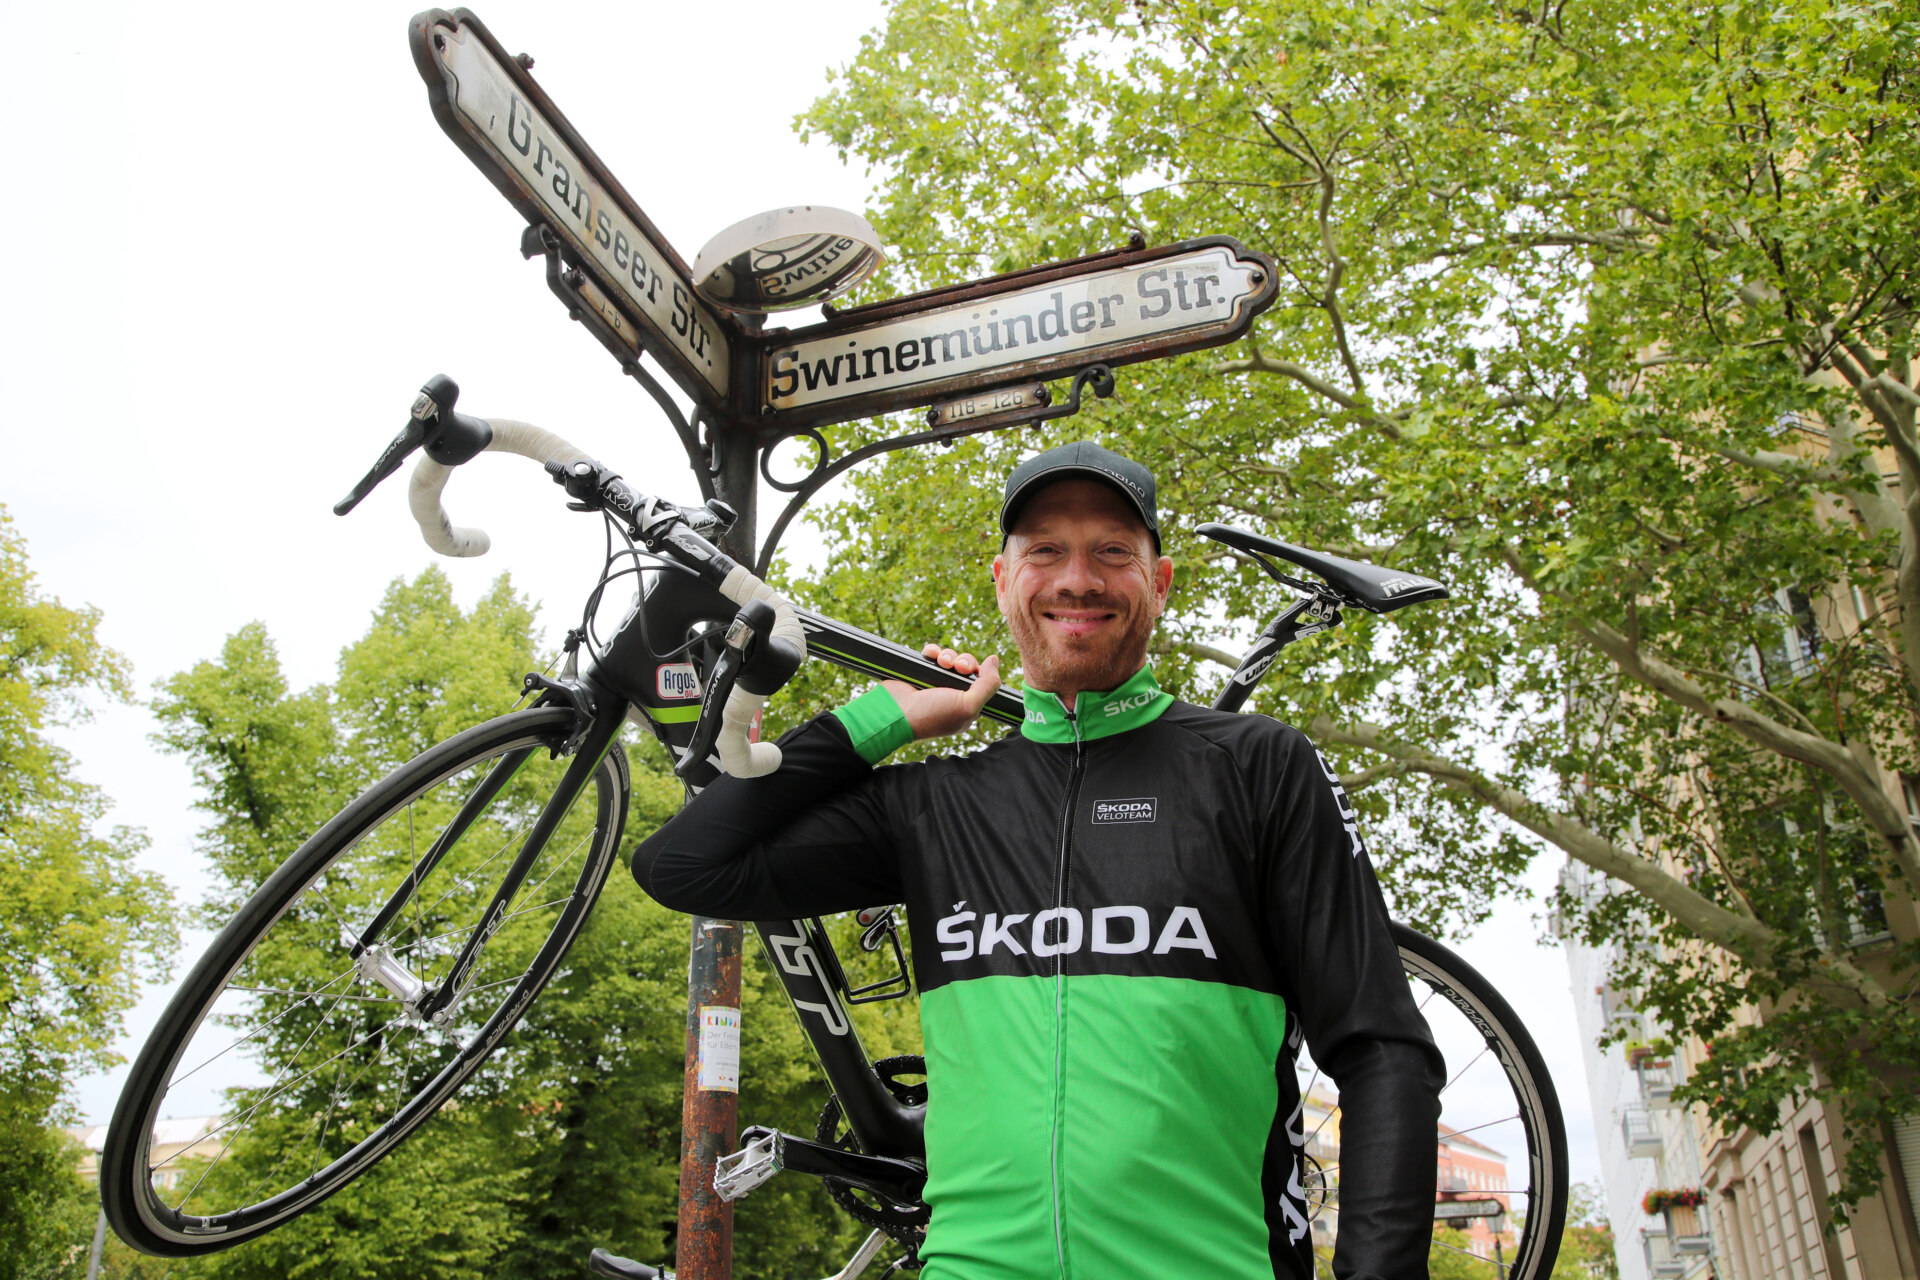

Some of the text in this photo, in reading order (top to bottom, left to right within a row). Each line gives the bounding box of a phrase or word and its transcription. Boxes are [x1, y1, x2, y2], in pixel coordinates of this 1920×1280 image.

[506, 92, 713, 367] Granseer Str.
[770, 268, 1226, 399] Swinemünder Str.
[664, 669, 697, 695] Argos
[1096, 803, 1153, 813] ŠKODA
[1096, 811, 1152, 821] VELOTEAM
[936, 900, 1217, 962] ŠKODA
[1444, 988, 1497, 1038] DURA-ACE
